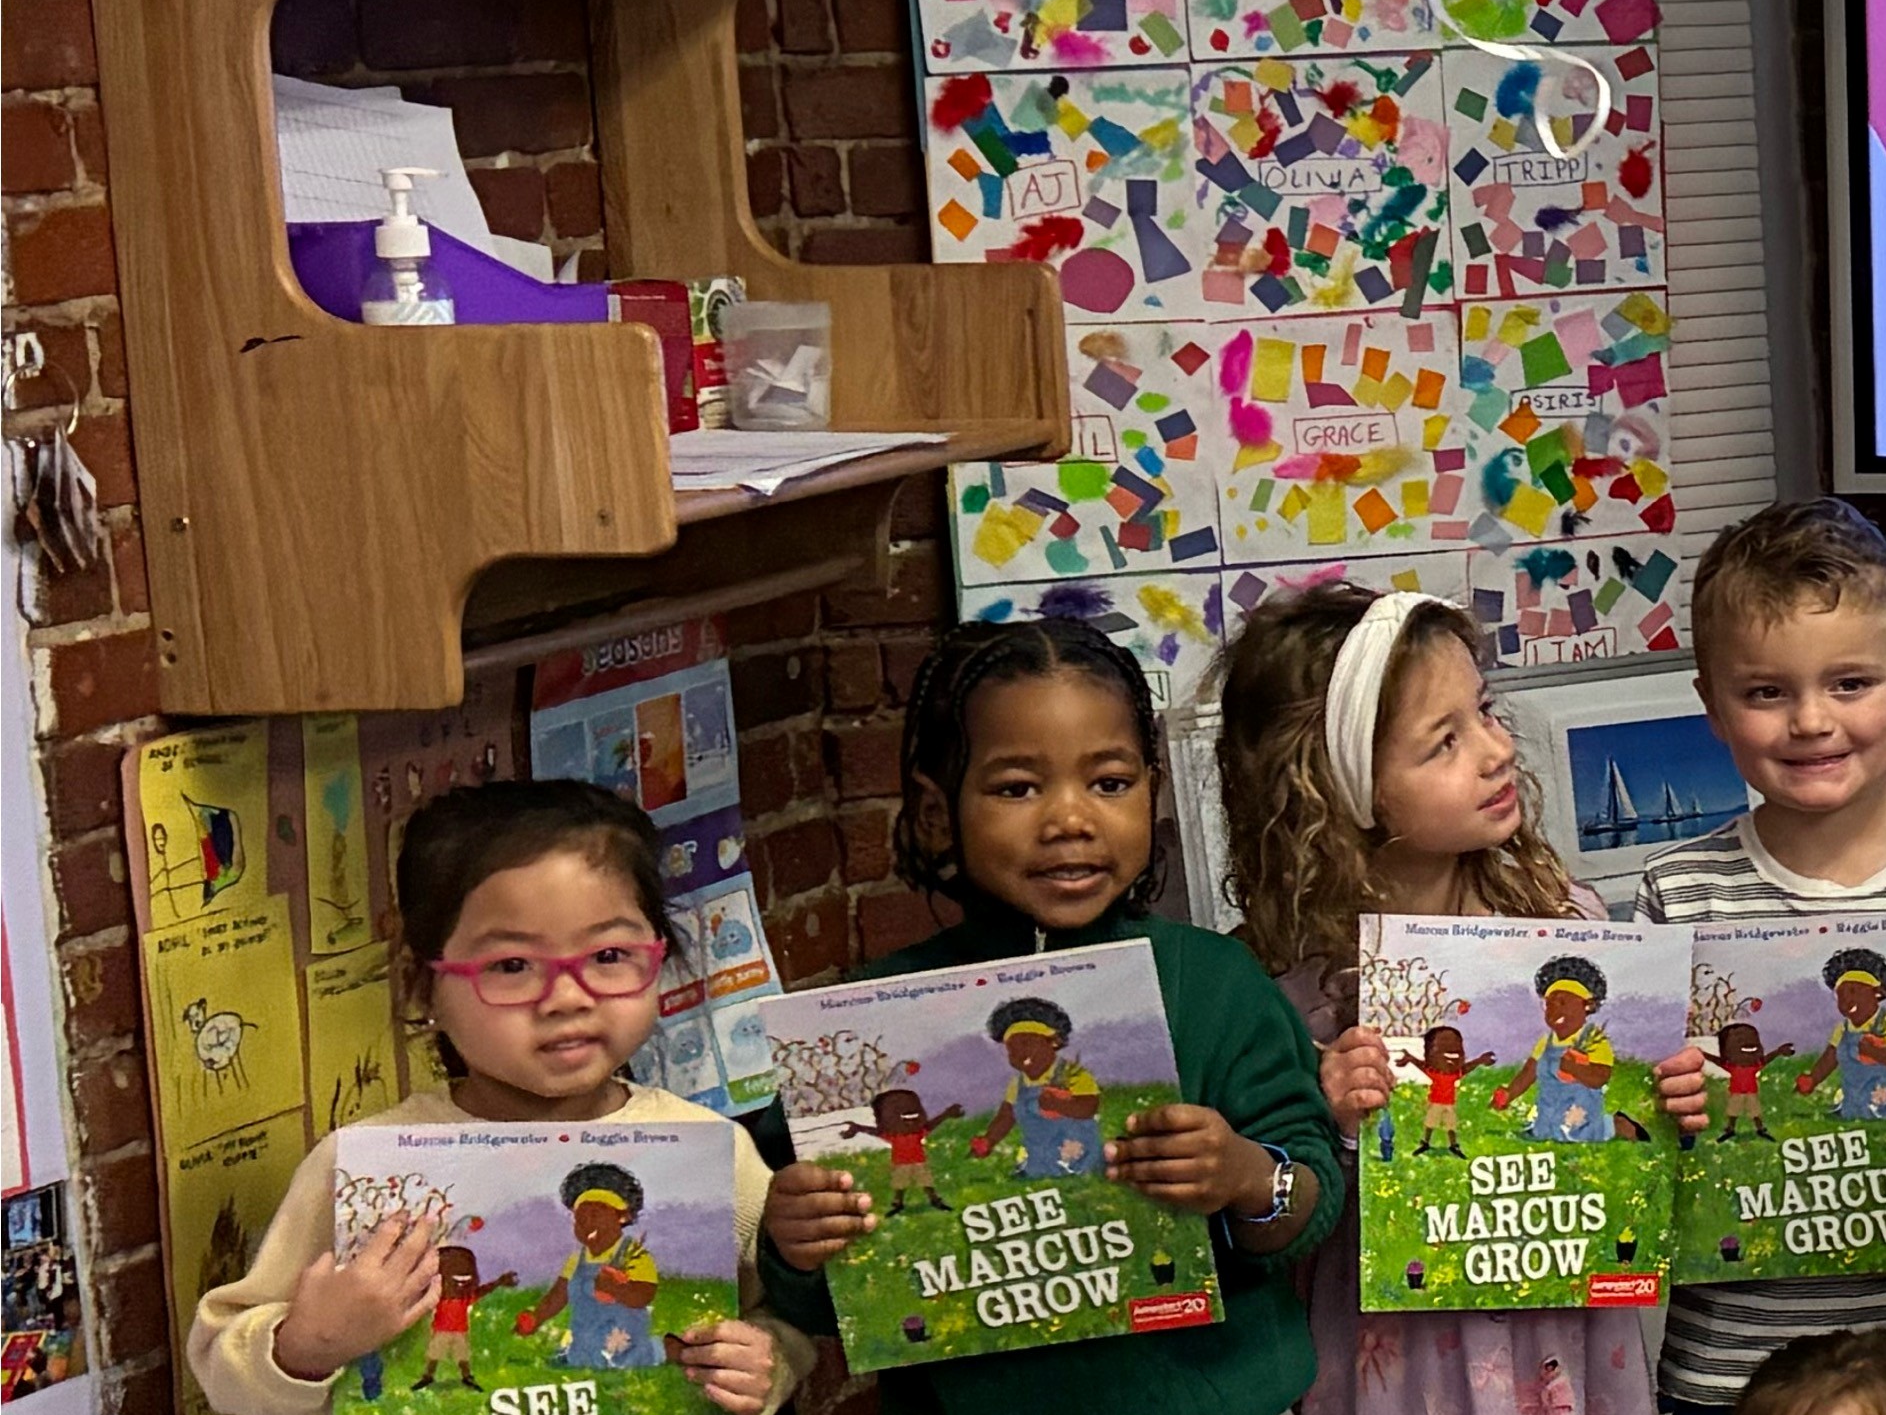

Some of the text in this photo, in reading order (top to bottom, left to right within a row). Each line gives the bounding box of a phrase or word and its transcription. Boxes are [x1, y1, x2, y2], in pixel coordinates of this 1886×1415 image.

[1500, 155, 1583, 184] TRIPP
[1022, 170, 1064, 213] AJ
[1517, 388, 1599, 412] OSIRIS
[1303, 421, 1386, 449] GRACE
[1471, 1152, 1555, 1194] SEE
[1782, 1130, 1870, 1173] SEE
[963, 1188, 1066, 1242] SEE
[1425, 1193, 1606, 1243] MARCUS
[913, 1220, 1134, 1297] MARCUS
[1466, 1238, 1589, 1284] GROW
[978, 1267, 1119, 1326] GROW
